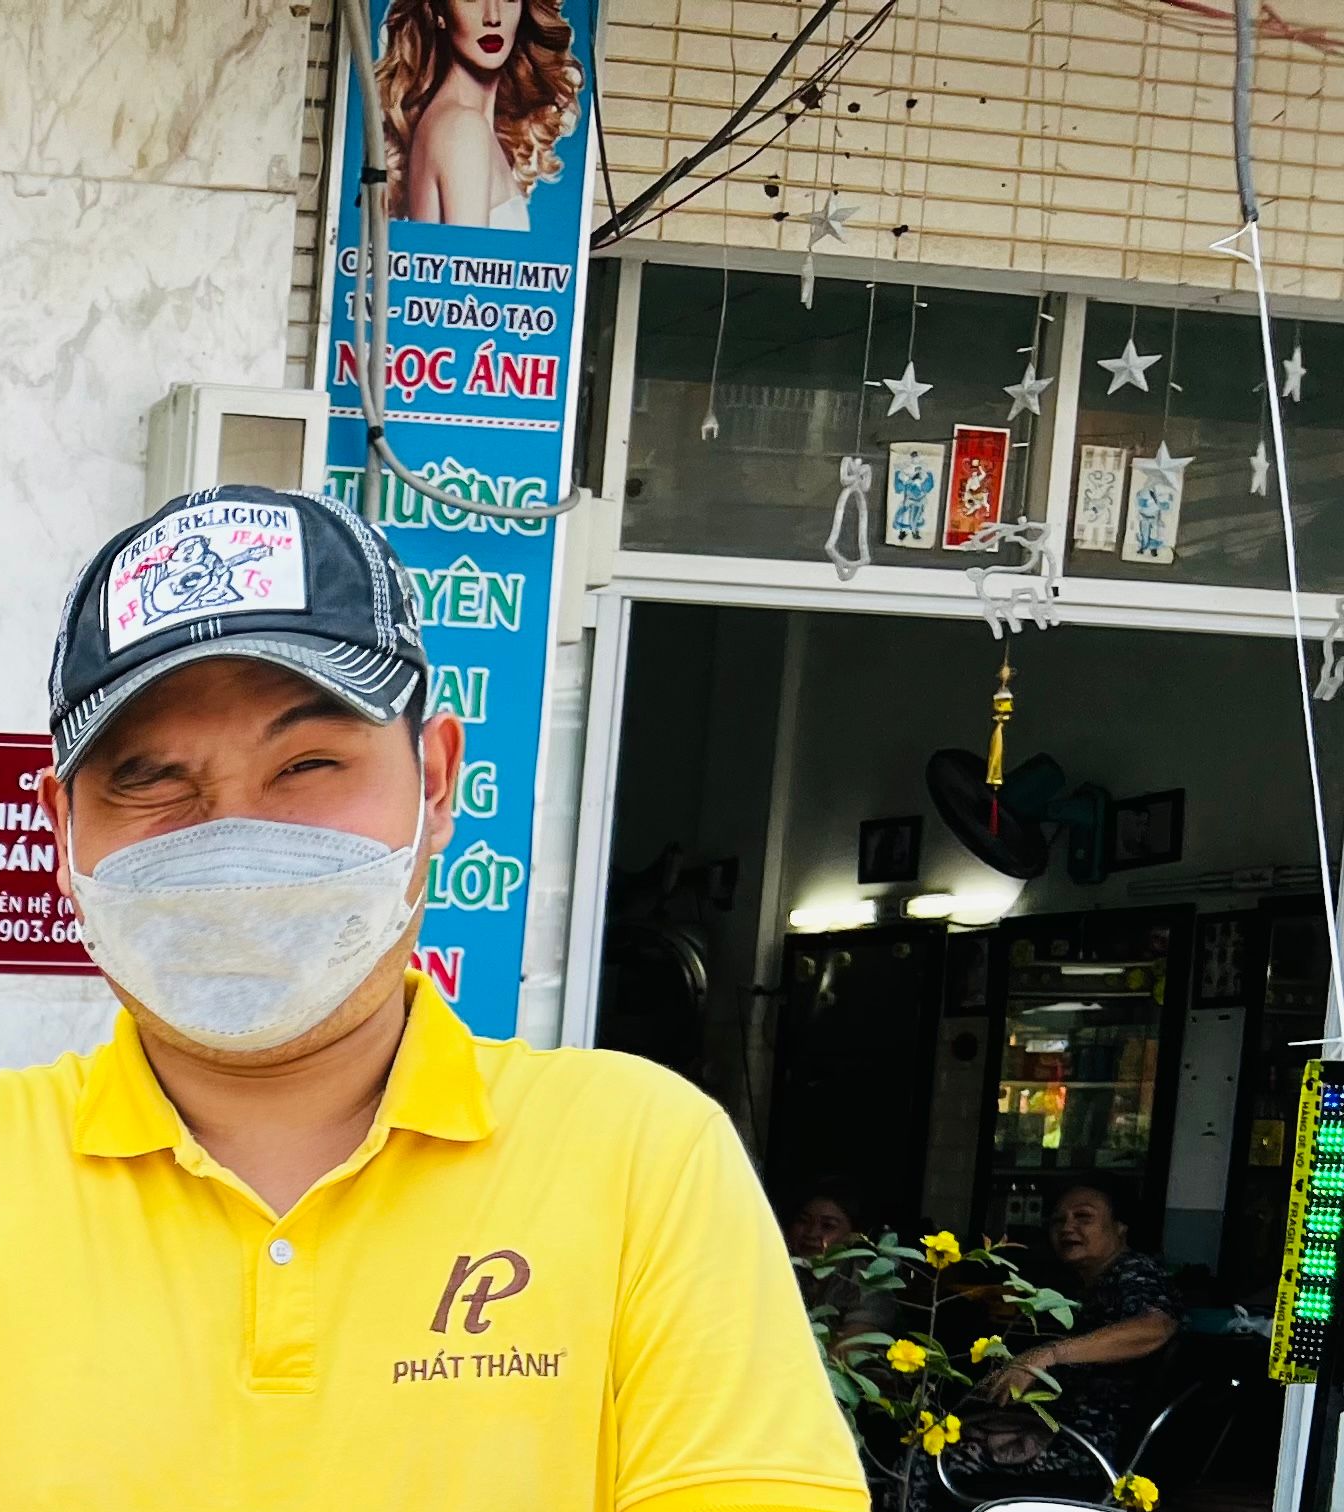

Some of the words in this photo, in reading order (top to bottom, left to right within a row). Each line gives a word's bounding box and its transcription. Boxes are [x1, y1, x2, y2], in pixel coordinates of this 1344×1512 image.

[339, 243, 409, 279] CG
[416, 256, 445, 281] TY
[453, 260, 512, 288] TNHH
[519, 265, 570, 291] MTV
[406, 300, 443, 324] DV
[446, 295, 499, 328] ĐÀO
[506, 307, 555, 340] TẠO
[335, 342, 454, 400] NỌC
[467, 341, 559, 399] ÁNH
[118, 526, 168, 569] TRUE
[177, 507, 290, 535] RELIGION
[228, 528, 294, 550] JEANS
[428, 843, 523, 907] LỚP
[27, 892, 51, 918] HỆ
[1285, 1201, 1301, 1257] FRAGILE
[393, 1348, 464, 1385] PHÁT
